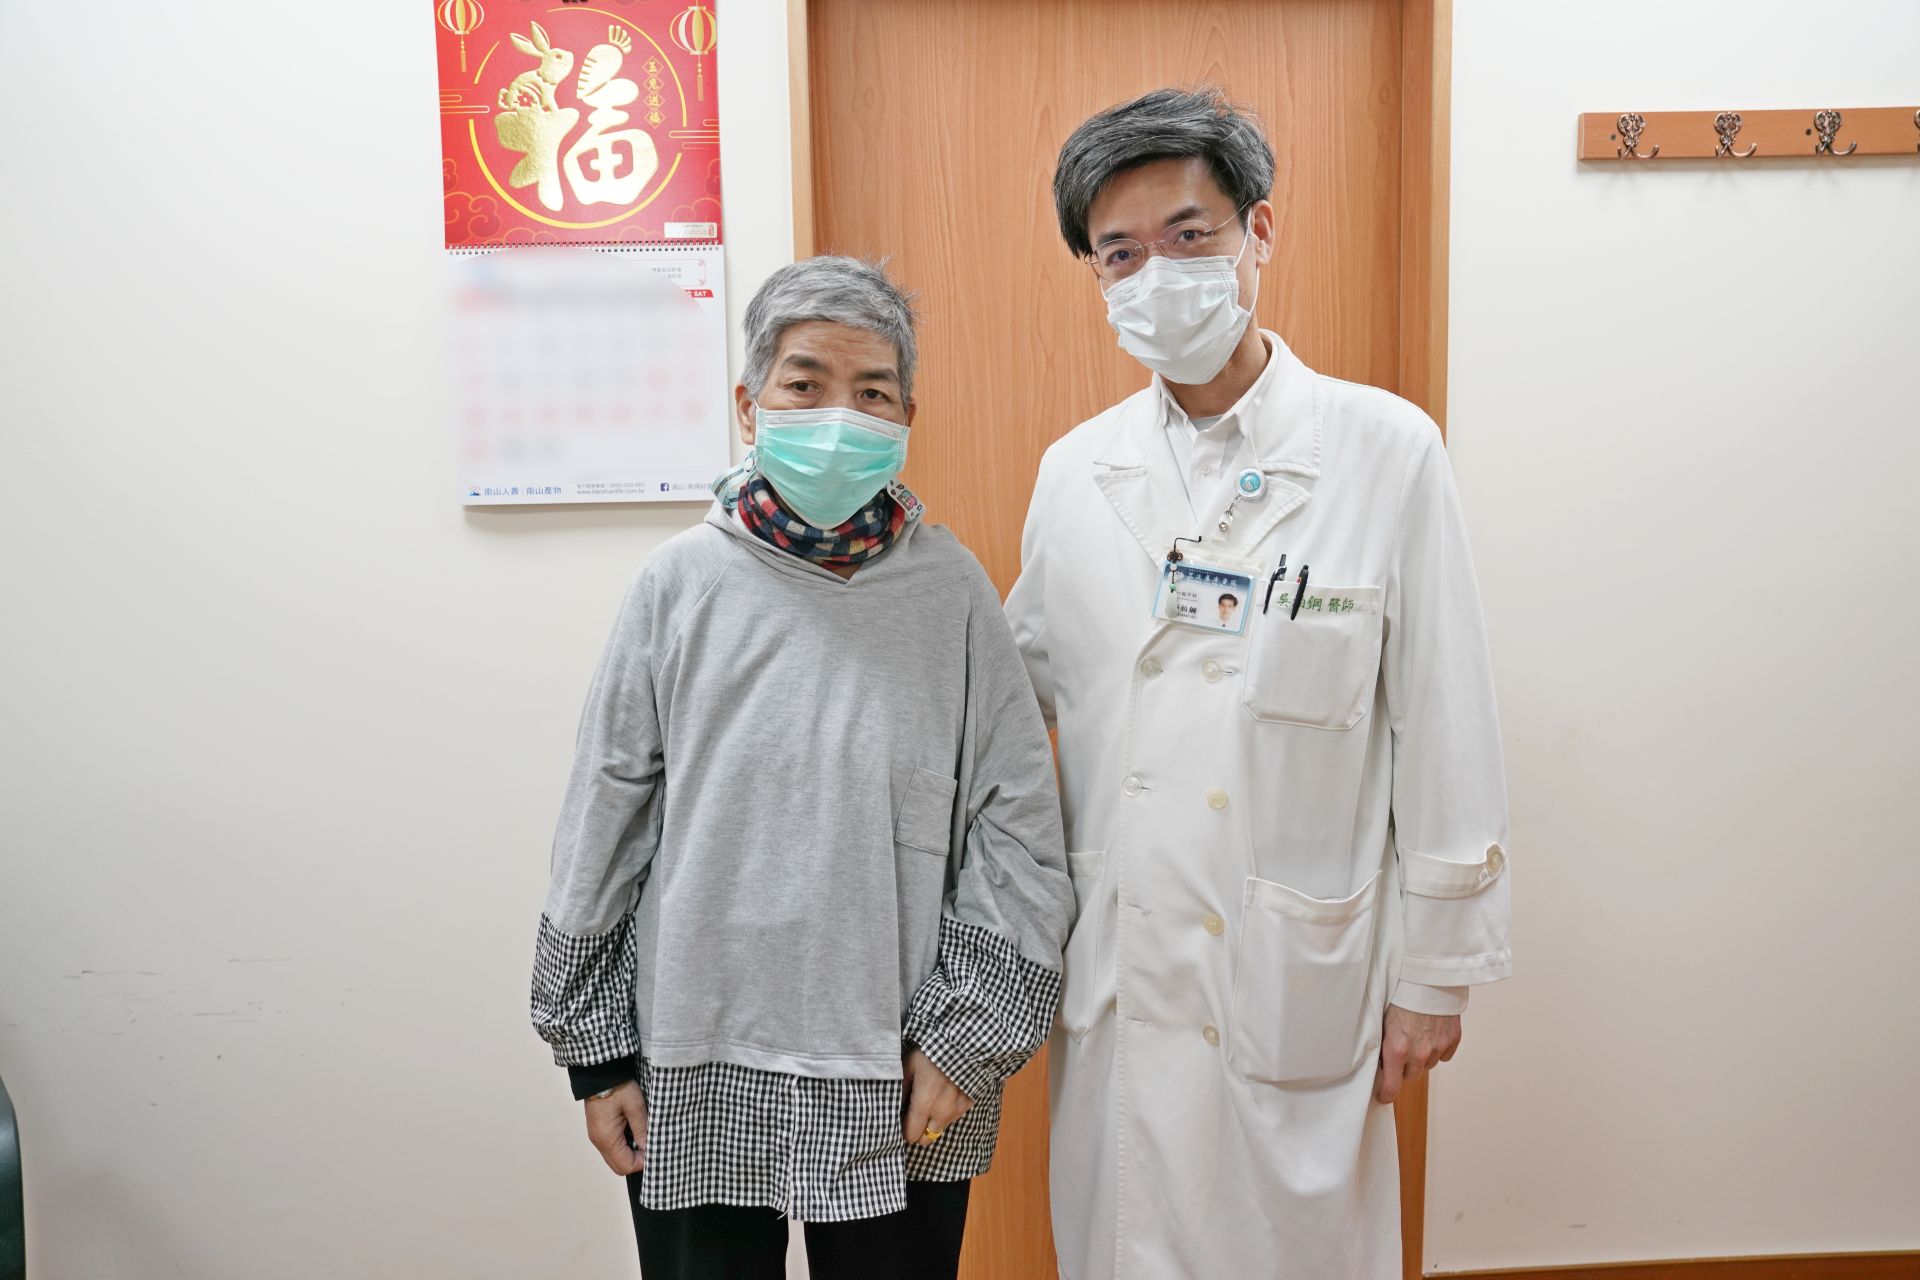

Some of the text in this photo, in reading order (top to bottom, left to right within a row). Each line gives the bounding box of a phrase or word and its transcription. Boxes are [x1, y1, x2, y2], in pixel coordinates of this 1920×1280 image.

[494, 20, 660, 212] 福
[484, 487, 519, 496] 南山人壽
[1328, 597, 1354, 613] 醫師
